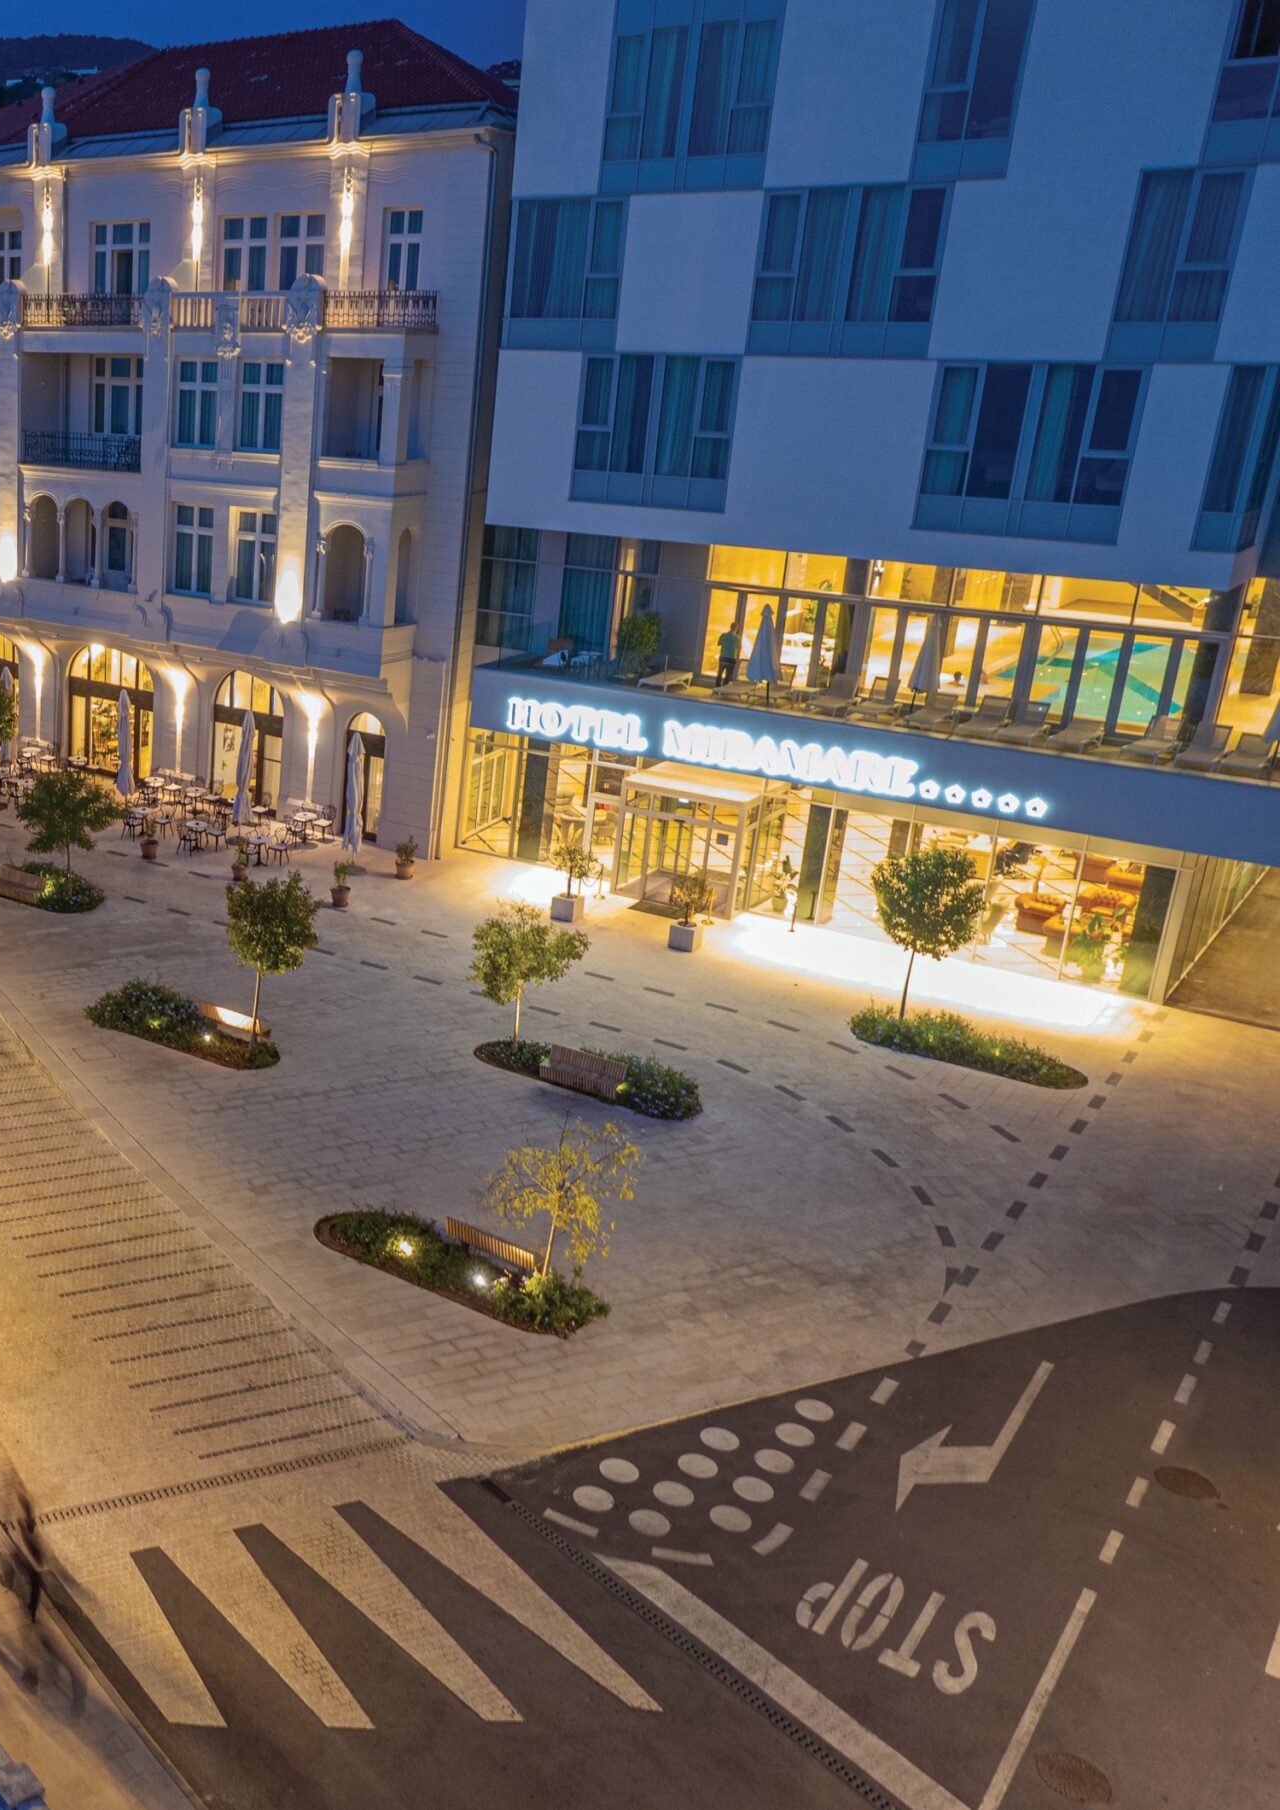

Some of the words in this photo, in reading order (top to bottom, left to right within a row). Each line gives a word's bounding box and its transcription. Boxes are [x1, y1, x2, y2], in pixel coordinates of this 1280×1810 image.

[506, 697, 648, 752] HOTEL
[662, 719, 919, 798] MIRAMARE
[795, 1557, 996, 1695] STOP
